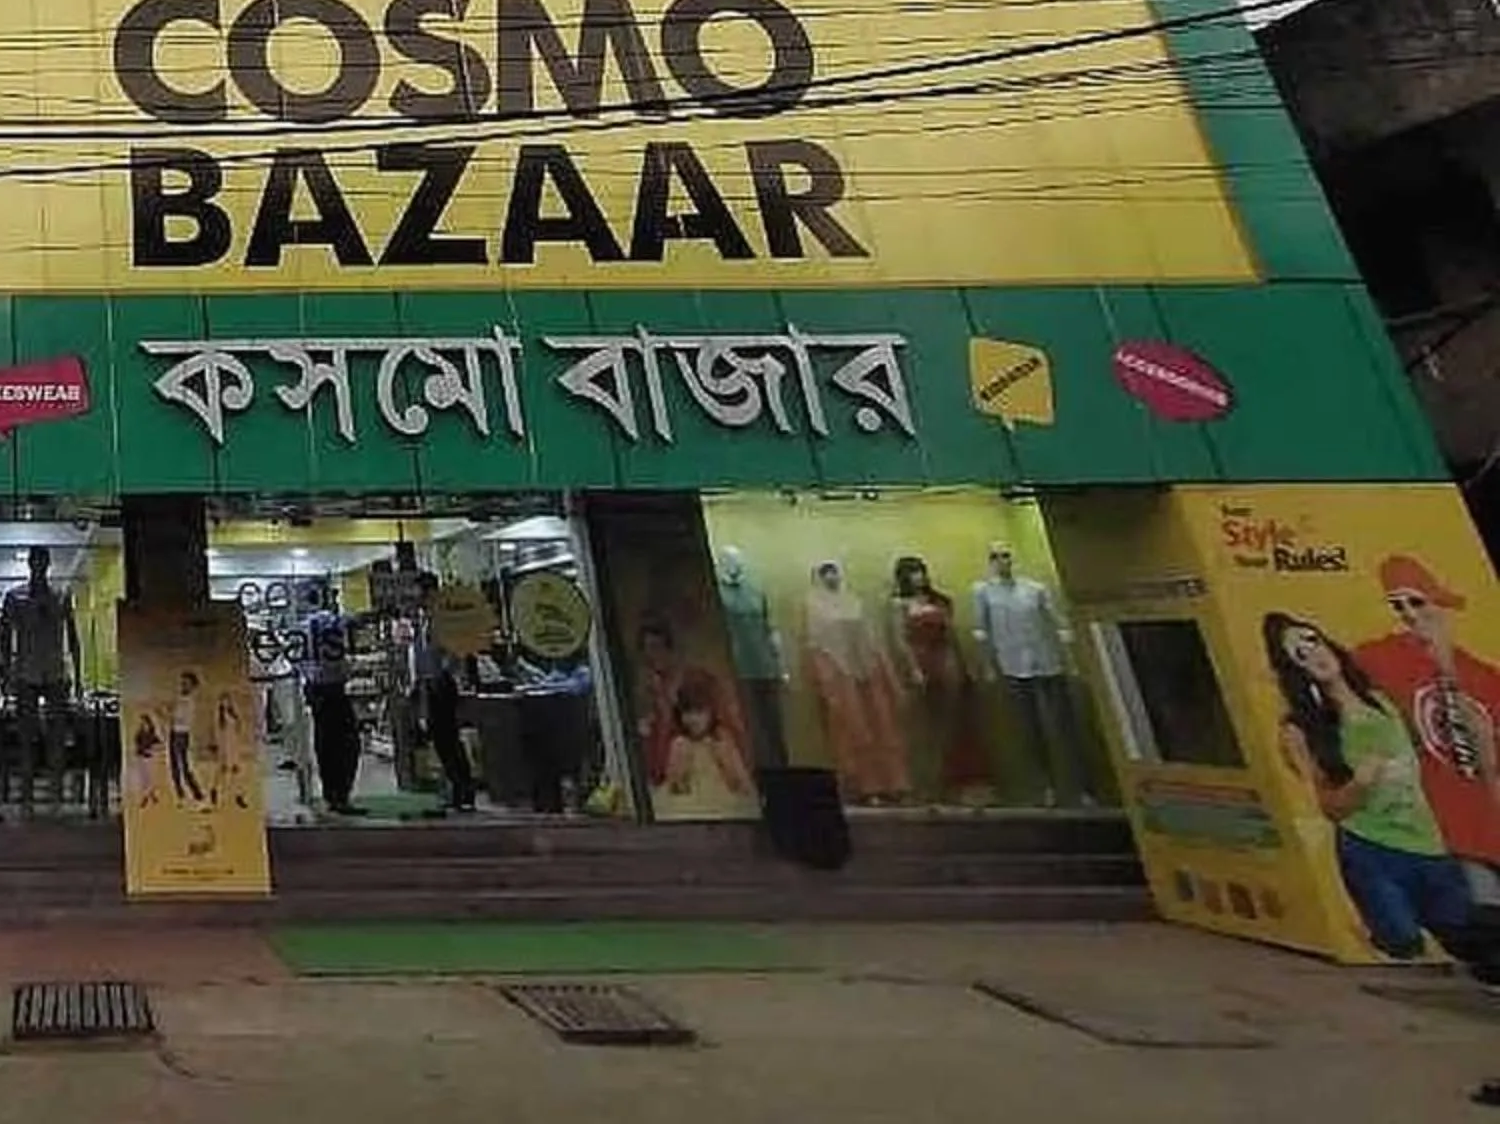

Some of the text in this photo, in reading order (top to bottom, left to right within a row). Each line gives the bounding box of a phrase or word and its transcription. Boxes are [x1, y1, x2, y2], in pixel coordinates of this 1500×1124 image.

[131, 138, 870, 268] BAZAAR
[139, 323, 918, 444] কসমো বাজার
